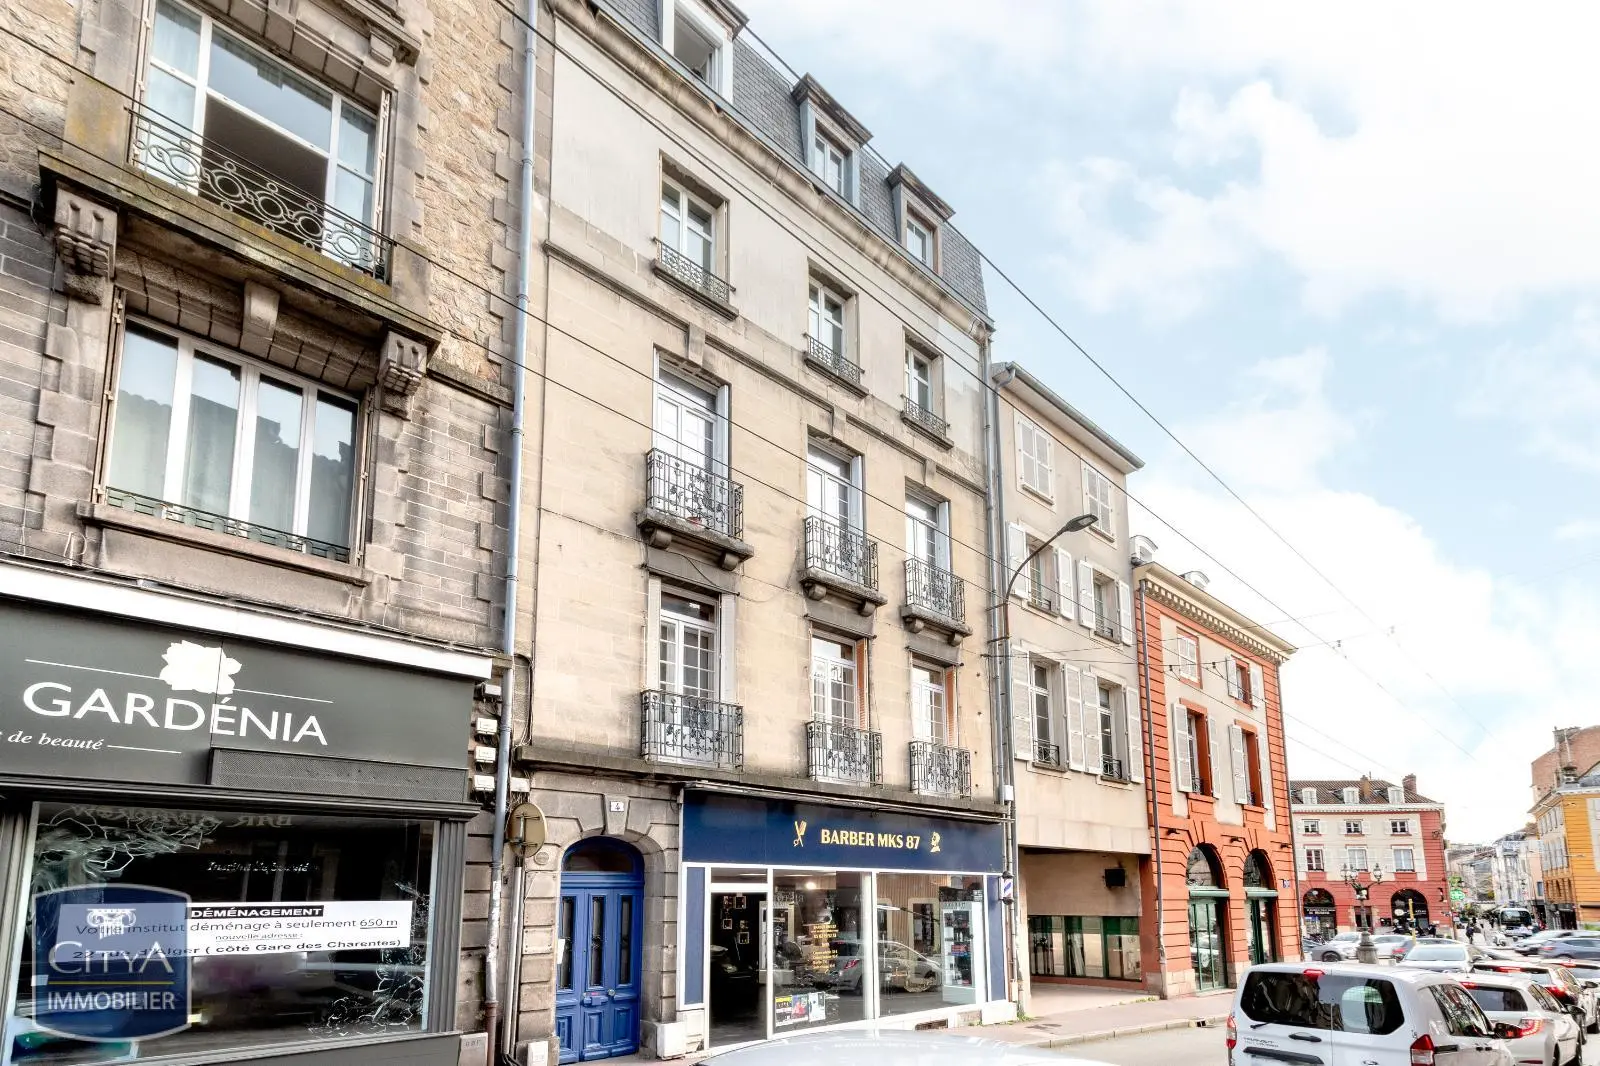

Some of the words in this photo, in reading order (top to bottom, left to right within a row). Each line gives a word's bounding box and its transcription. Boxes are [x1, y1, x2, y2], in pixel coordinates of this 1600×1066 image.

[23, 682, 328, 746] GARDÉNIA
[7, 730, 33, 744] de
[38, 732, 105, 750] beauté
[821, 828, 875, 847] BARBER
[877, 833, 904, 849] MKS
[905, 835, 921, 850] 87
[191, 907, 323, 918] DÉMÉNAGEMENT
[128, 922, 185, 934] institut
[190, 919, 271, 932] déménage
[274, 920, 282, 929] à
[286, 919, 357, 929] seulement
[360, 918, 383, 928] 650
[386, 919, 398, 927] m
[215, 932, 260, 941] nouvelle
[216, 944, 250, 953] côté
[255, 943, 292, 951] Gare
[296, 942, 322, 950] des
[327, 939, 401, 949] Charentes)
